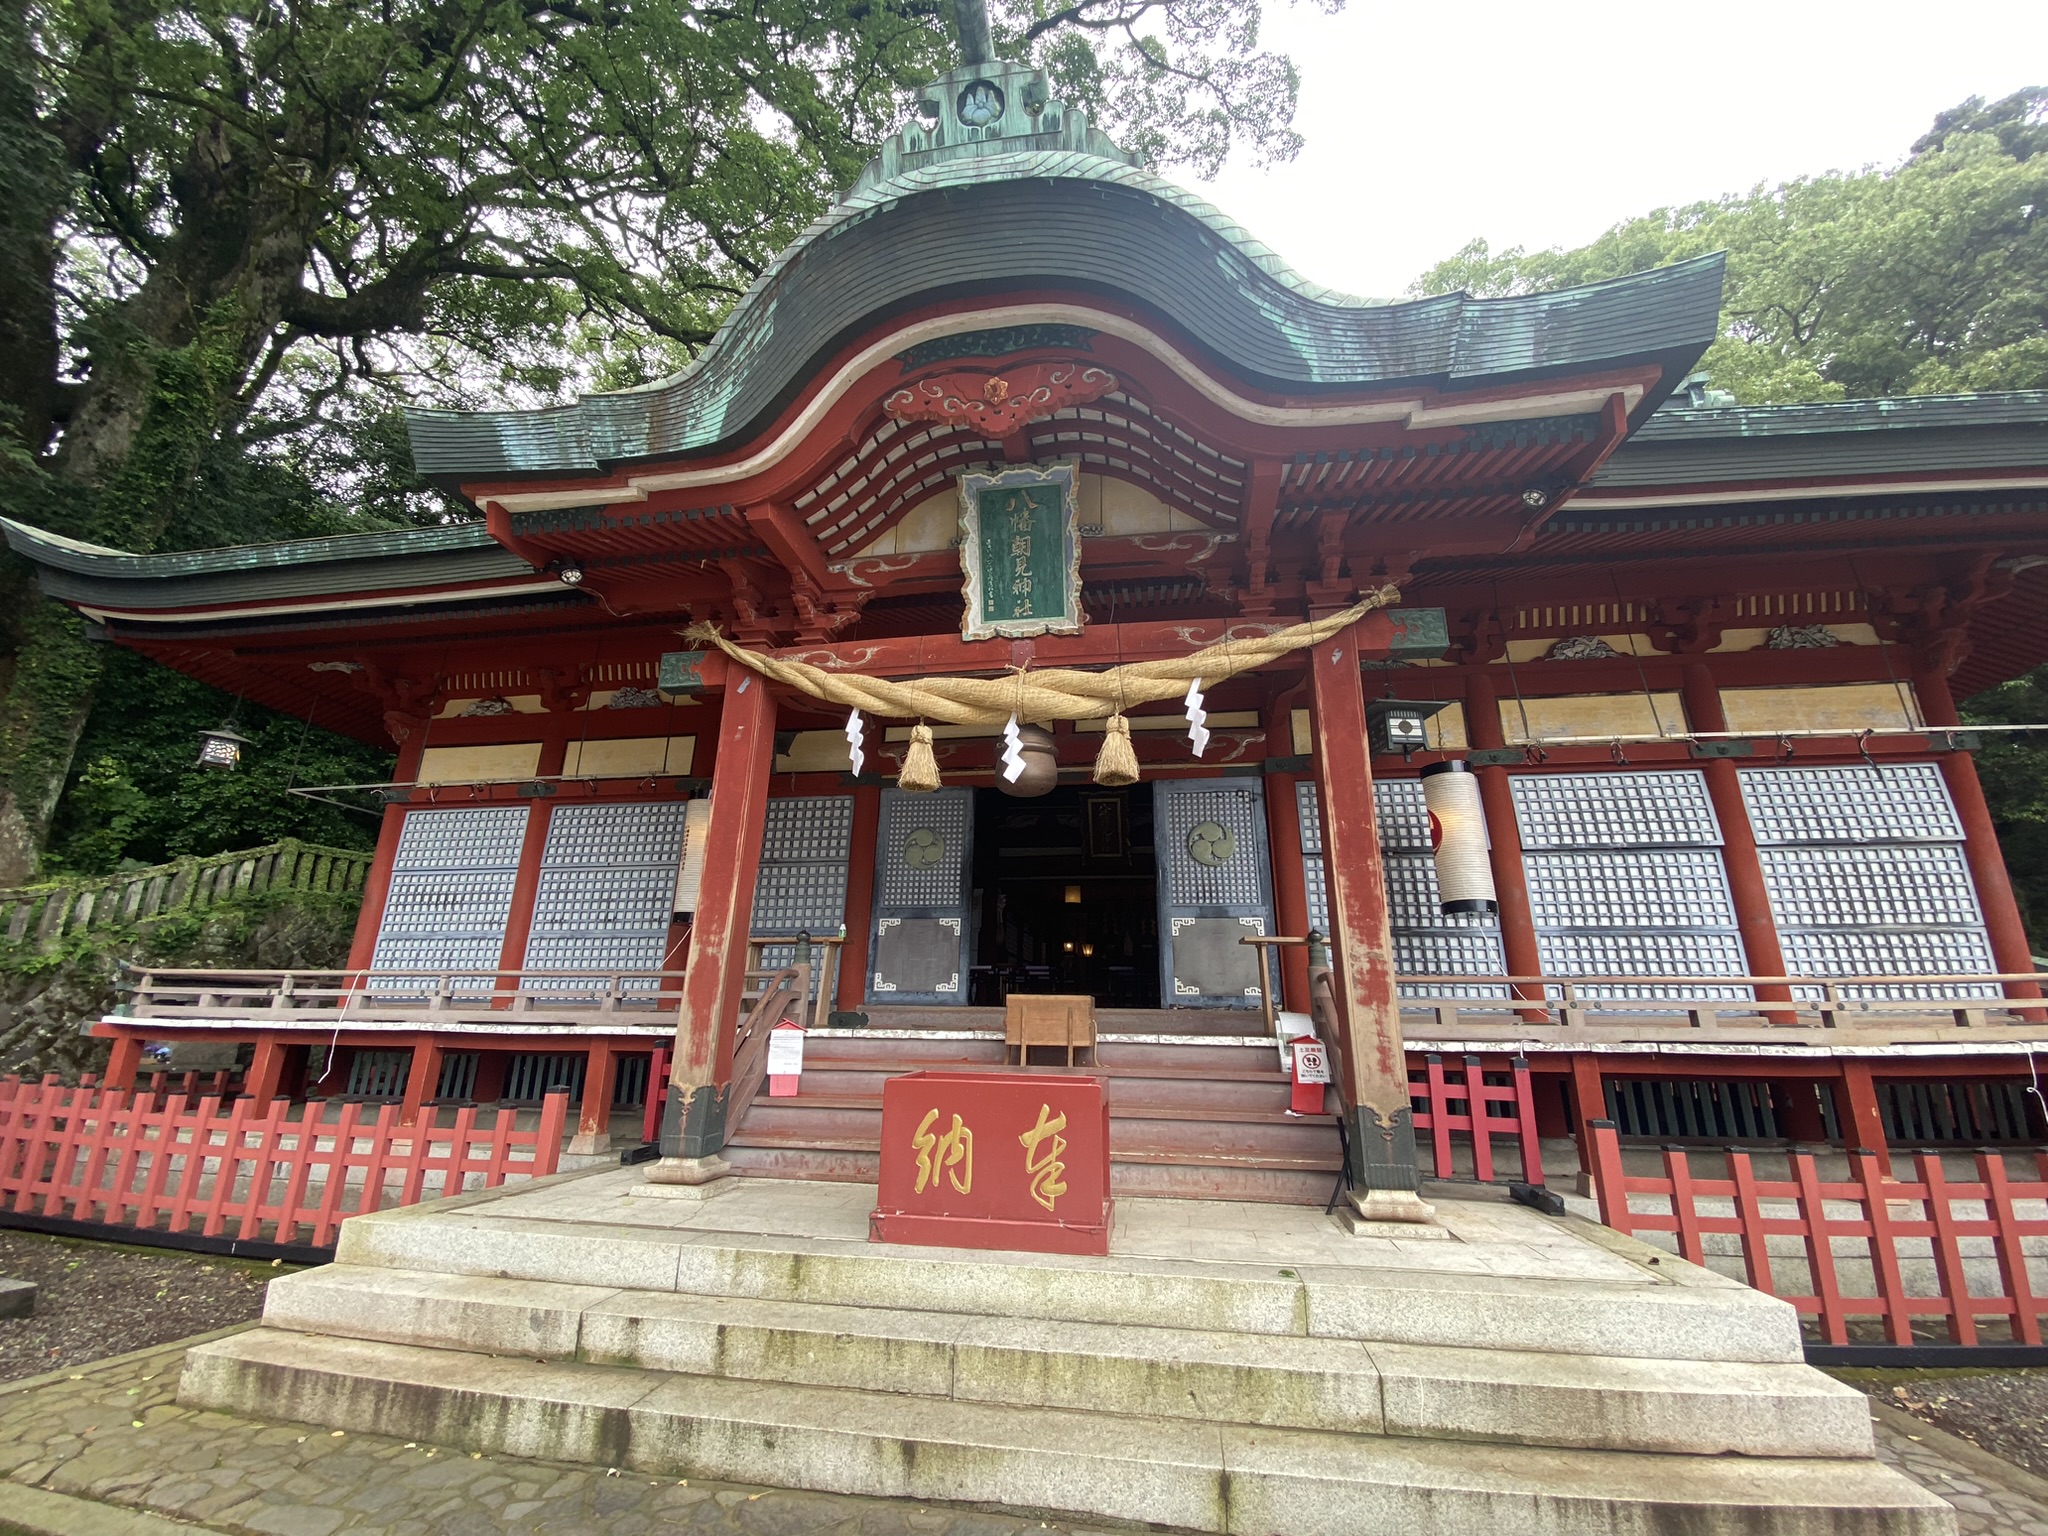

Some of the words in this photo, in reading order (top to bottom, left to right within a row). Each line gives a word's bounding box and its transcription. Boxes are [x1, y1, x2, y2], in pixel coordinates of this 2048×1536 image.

[1006, 489, 1038, 618] 八幡朝見神社
